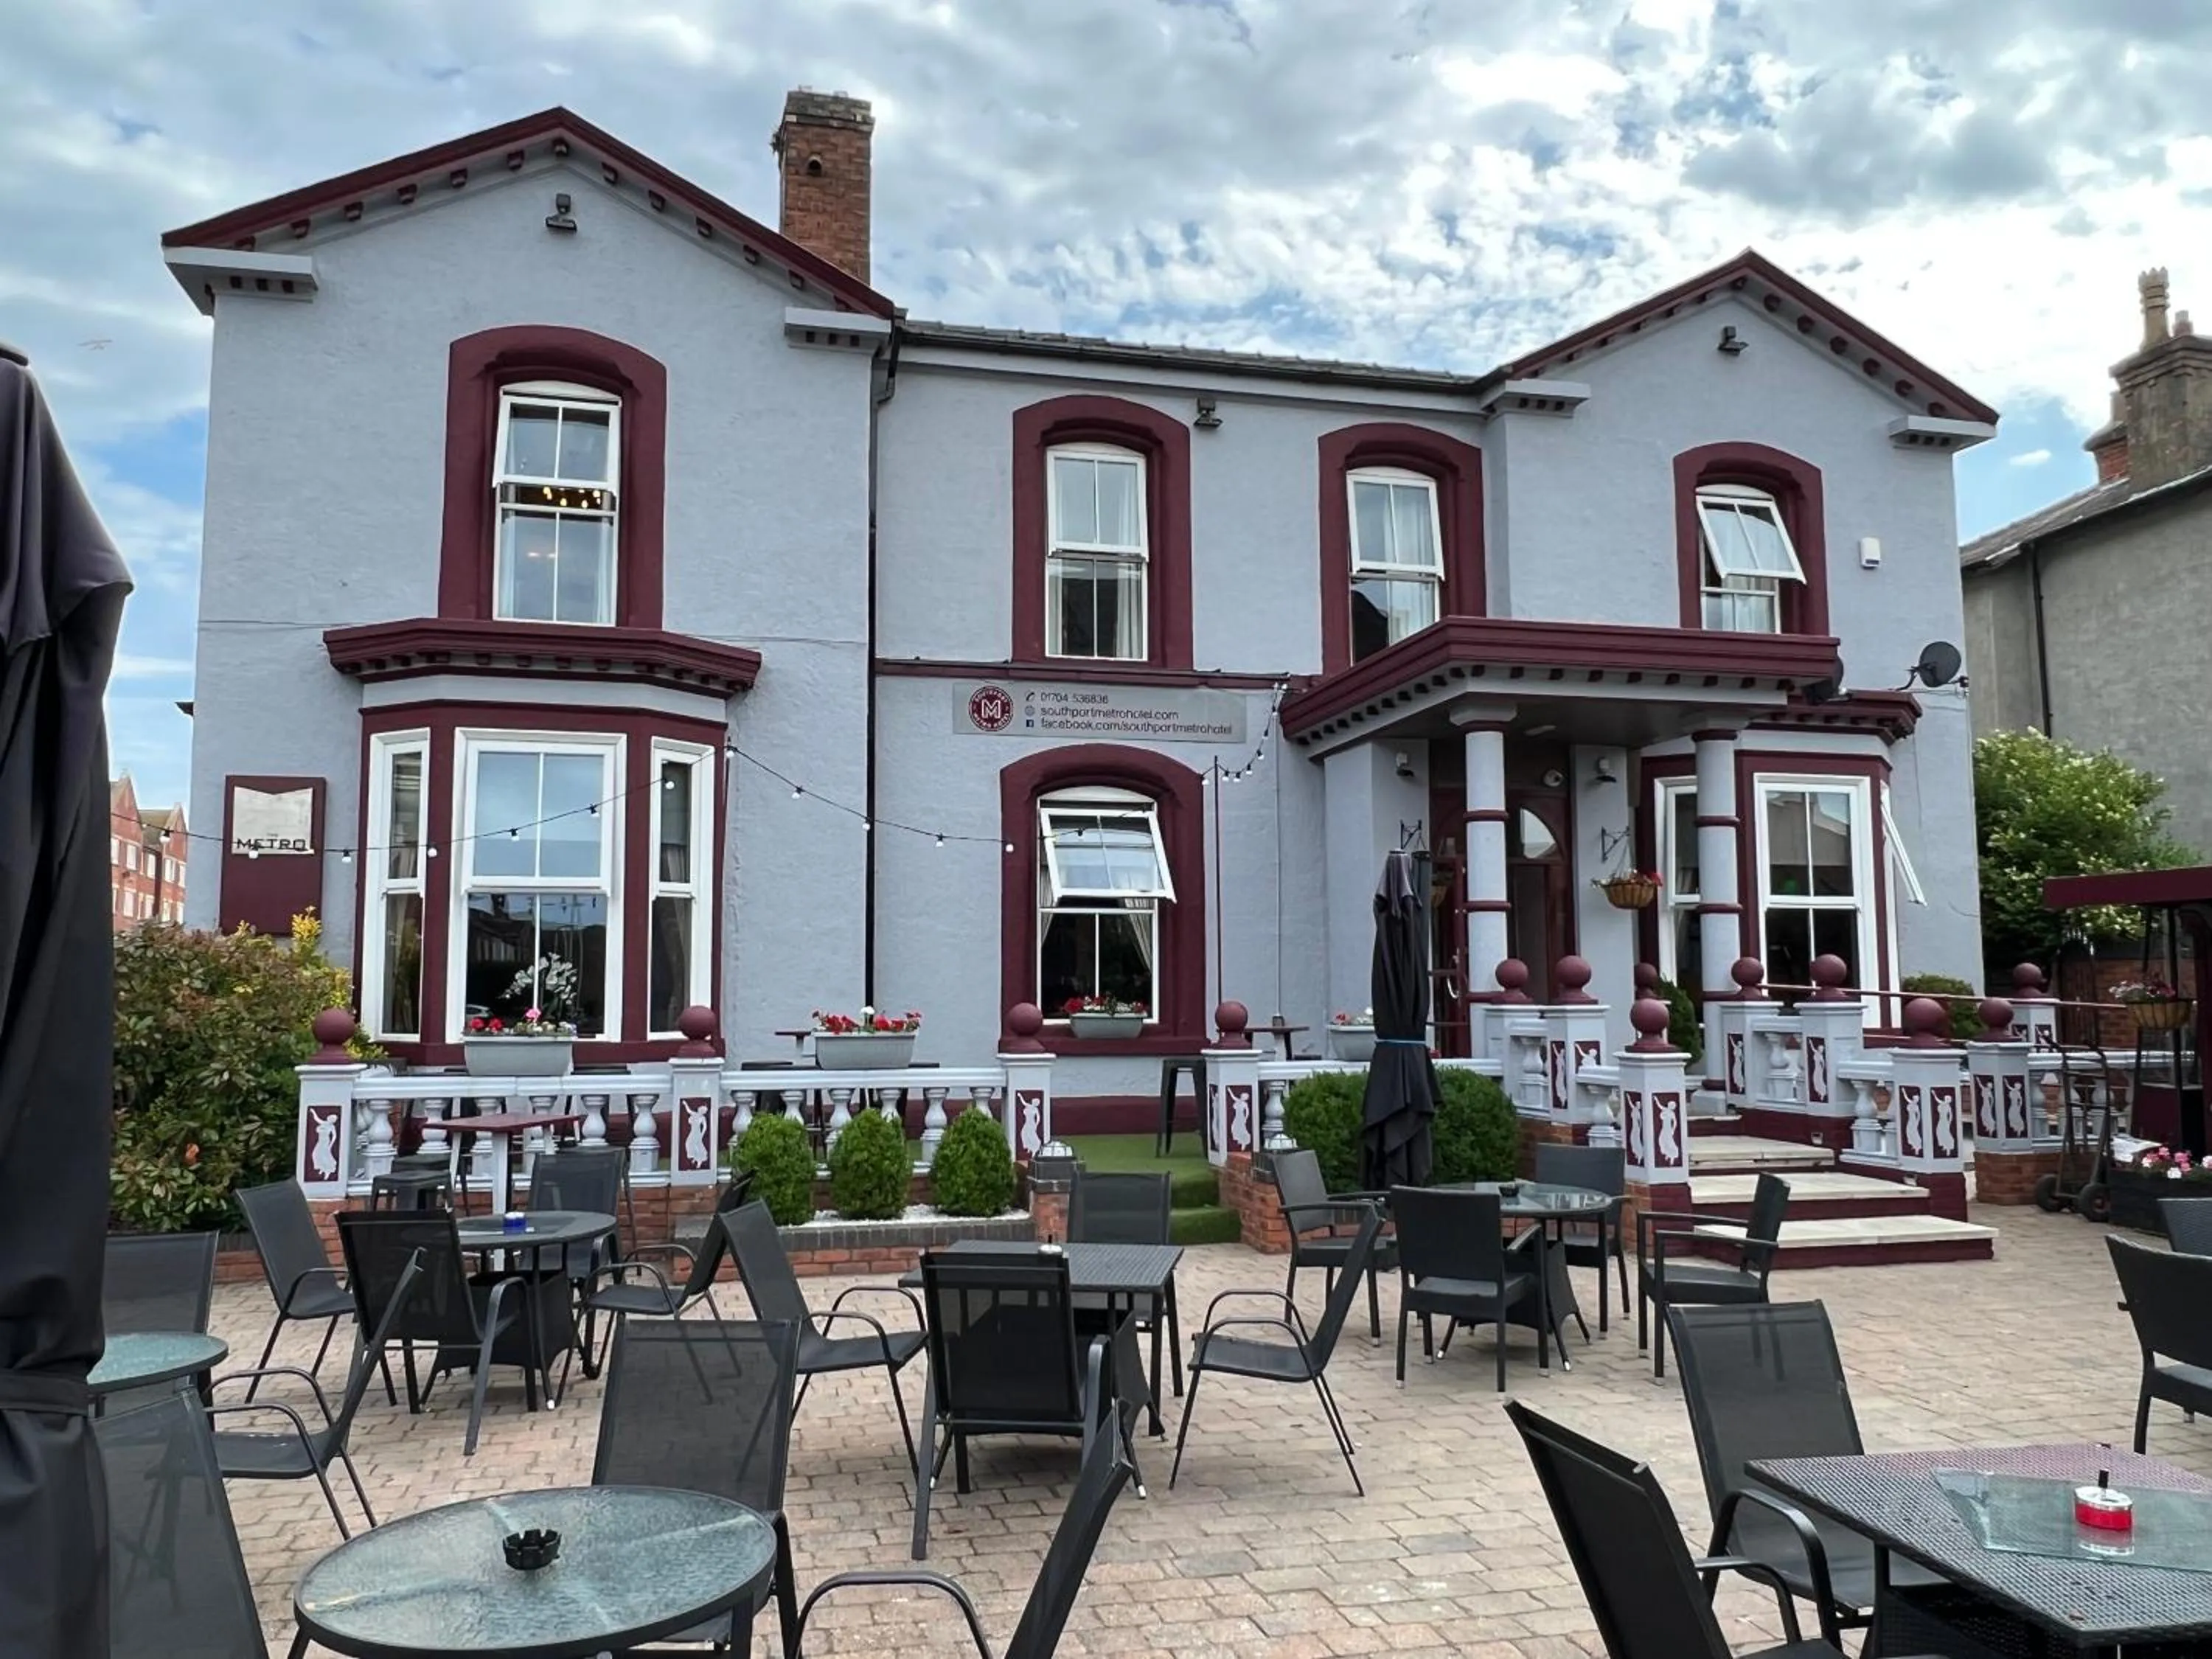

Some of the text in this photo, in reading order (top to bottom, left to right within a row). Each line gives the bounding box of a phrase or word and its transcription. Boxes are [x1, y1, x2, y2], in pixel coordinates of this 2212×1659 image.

[1040, 692, 1068, 703] 01704
[981, 699, 1001, 719] M
[1040, 706, 1179, 720] southportmetrohotel.com
[1040, 717, 1232, 734] facebook.com/southportmetrohotel
